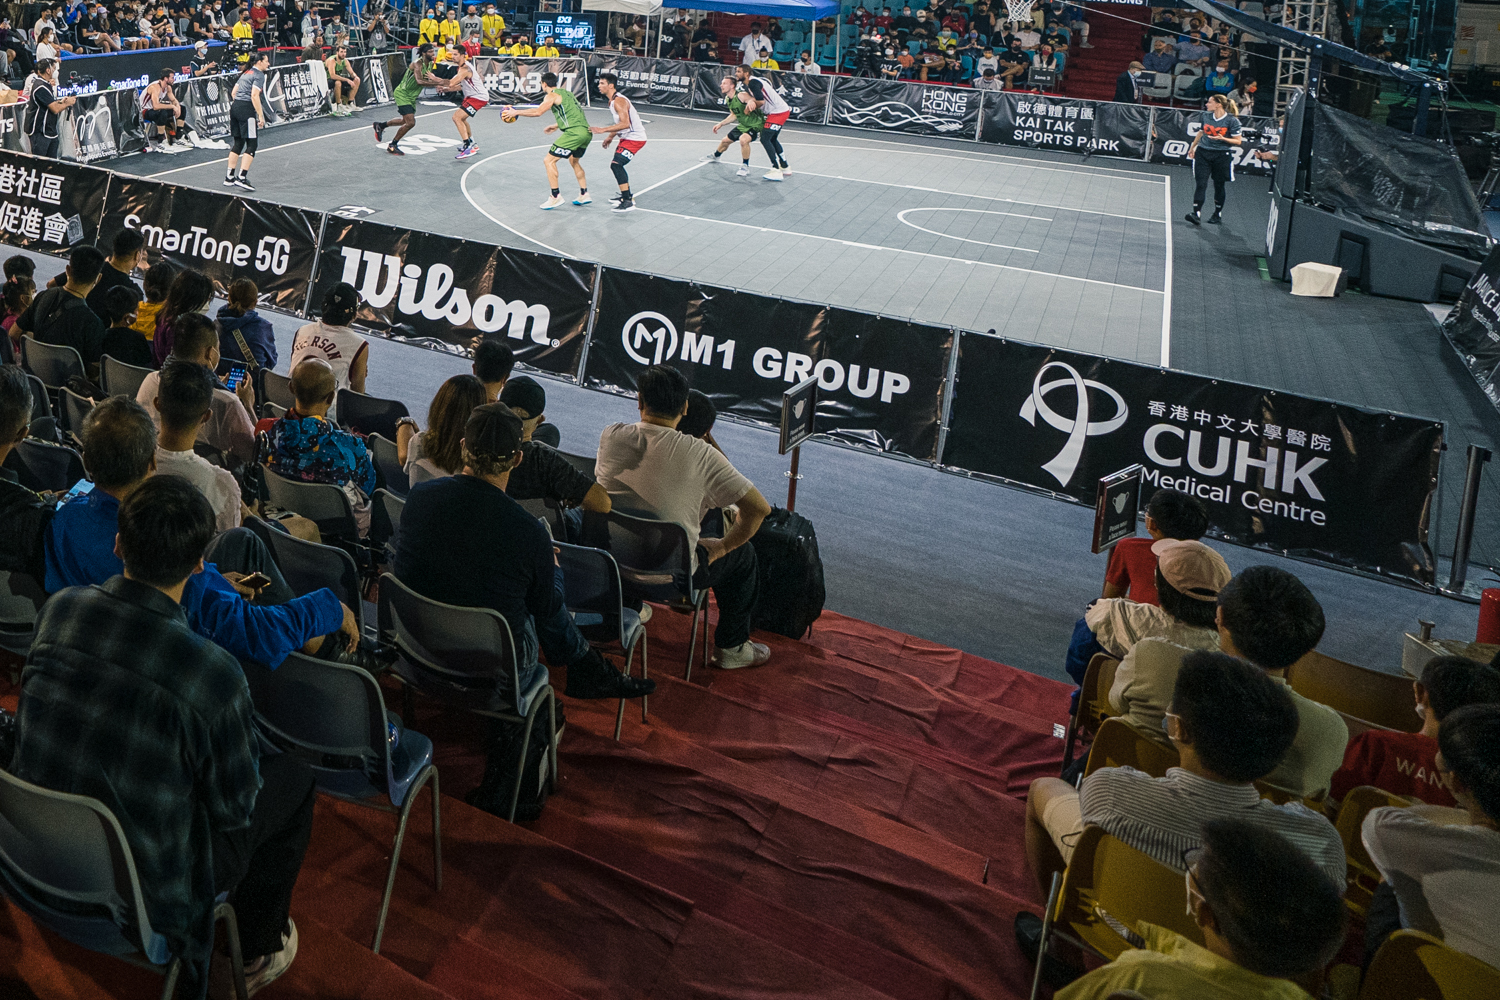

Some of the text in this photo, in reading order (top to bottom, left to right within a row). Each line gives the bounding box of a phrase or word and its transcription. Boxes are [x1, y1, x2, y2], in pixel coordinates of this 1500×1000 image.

[626, 80, 649, 89] Events
[650, 83, 689, 93] Committee
[923, 90, 968, 103] HONG
[921, 99, 967, 113] KONG
[1015, 115, 1075, 133] KAI TAK
[1013, 129, 1120, 152] SPORTS PARK
[255, 235, 291, 276] 5G
[341, 246, 550, 346] Wilson
[681, 331, 910, 404] M1 GROUP
[1147, 400, 1332, 452] 香港中文大學醫院
[1142, 422, 1329, 502] CUHK
[1140, 467, 1326, 526] Medical Centre
[1396, 756, 1443, 790] WAN
